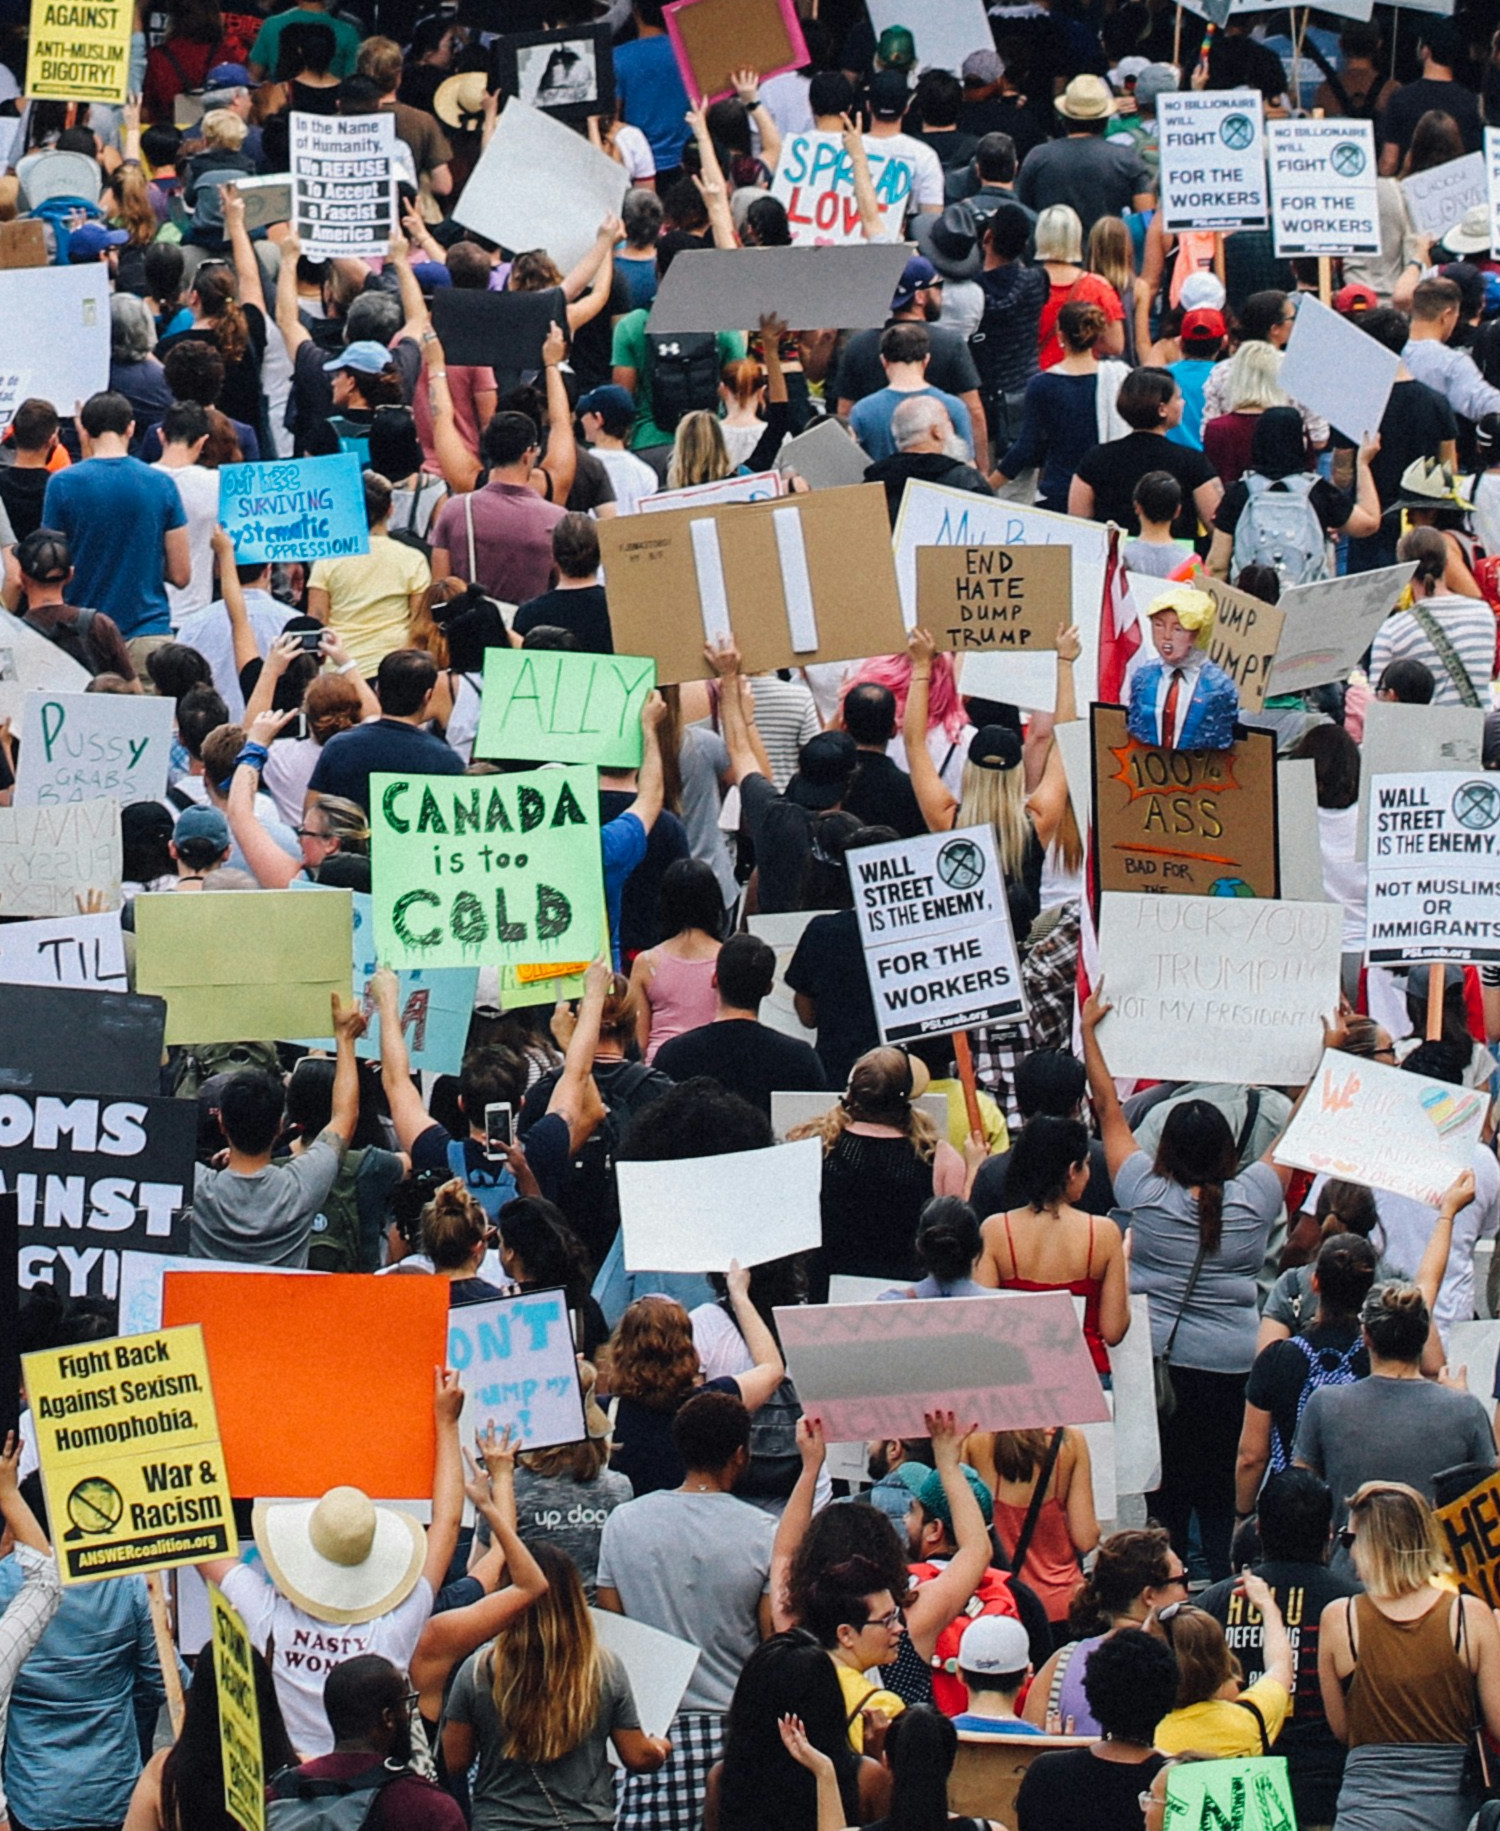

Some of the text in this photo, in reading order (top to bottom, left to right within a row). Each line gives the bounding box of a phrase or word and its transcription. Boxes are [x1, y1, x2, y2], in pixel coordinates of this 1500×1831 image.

[44, 4, 119, 29] AGAINST
[35, 39, 124, 61] ANTI-MUSLIM
[41, 60, 115, 84] BIGOTRY!
[1165, 98, 1256, 110] NO BILLIONAIRE
[297, 119, 378, 136] In the Name
[1166, 116, 1194, 126] WILL
[296, 137, 309, 155] of
[1166, 131, 1216, 148] FIGHT
[299, 159, 385, 177] We REFUSE
[1169, 167, 1243, 185] FOR THE
[308, 181, 378, 200] To Accept
[1170, 190, 1260, 207] WORKERS
[309, 203, 375, 219] a Fascist
[311, 225, 373, 242] America
[966, 549, 1012, 574] END
[956, 577, 1024, 601] HATE
[961, 603, 1022, 622] DUMP
[947, 627, 1031, 648] TRUMP
[502, 658, 652, 738] ALLY
[381, 780, 589, 837] CANADA
[434, 844, 529, 875] is too
[858, 857, 915, 883] WALL
[863, 877, 933, 907] STREET
[392, 883, 574, 958] COLD
[868, 892, 993, 933] IS THE ENEMY,
[877, 939, 982, 978] FOR THE
[883, 965, 1010, 1009] WORKERS
[58, 1340, 169, 1379] Fight Back
[38, 1374, 204, 1420] Against Sexism,
[54, 1409, 199, 1452] Homophobia,
[141, 1460, 218, 1493] War &
[130, 1494, 222, 1532] Racism
[78, 1532, 218, 1569] ANSWERcoalition.org
[292, 1629, 369, 1654] NASTY
